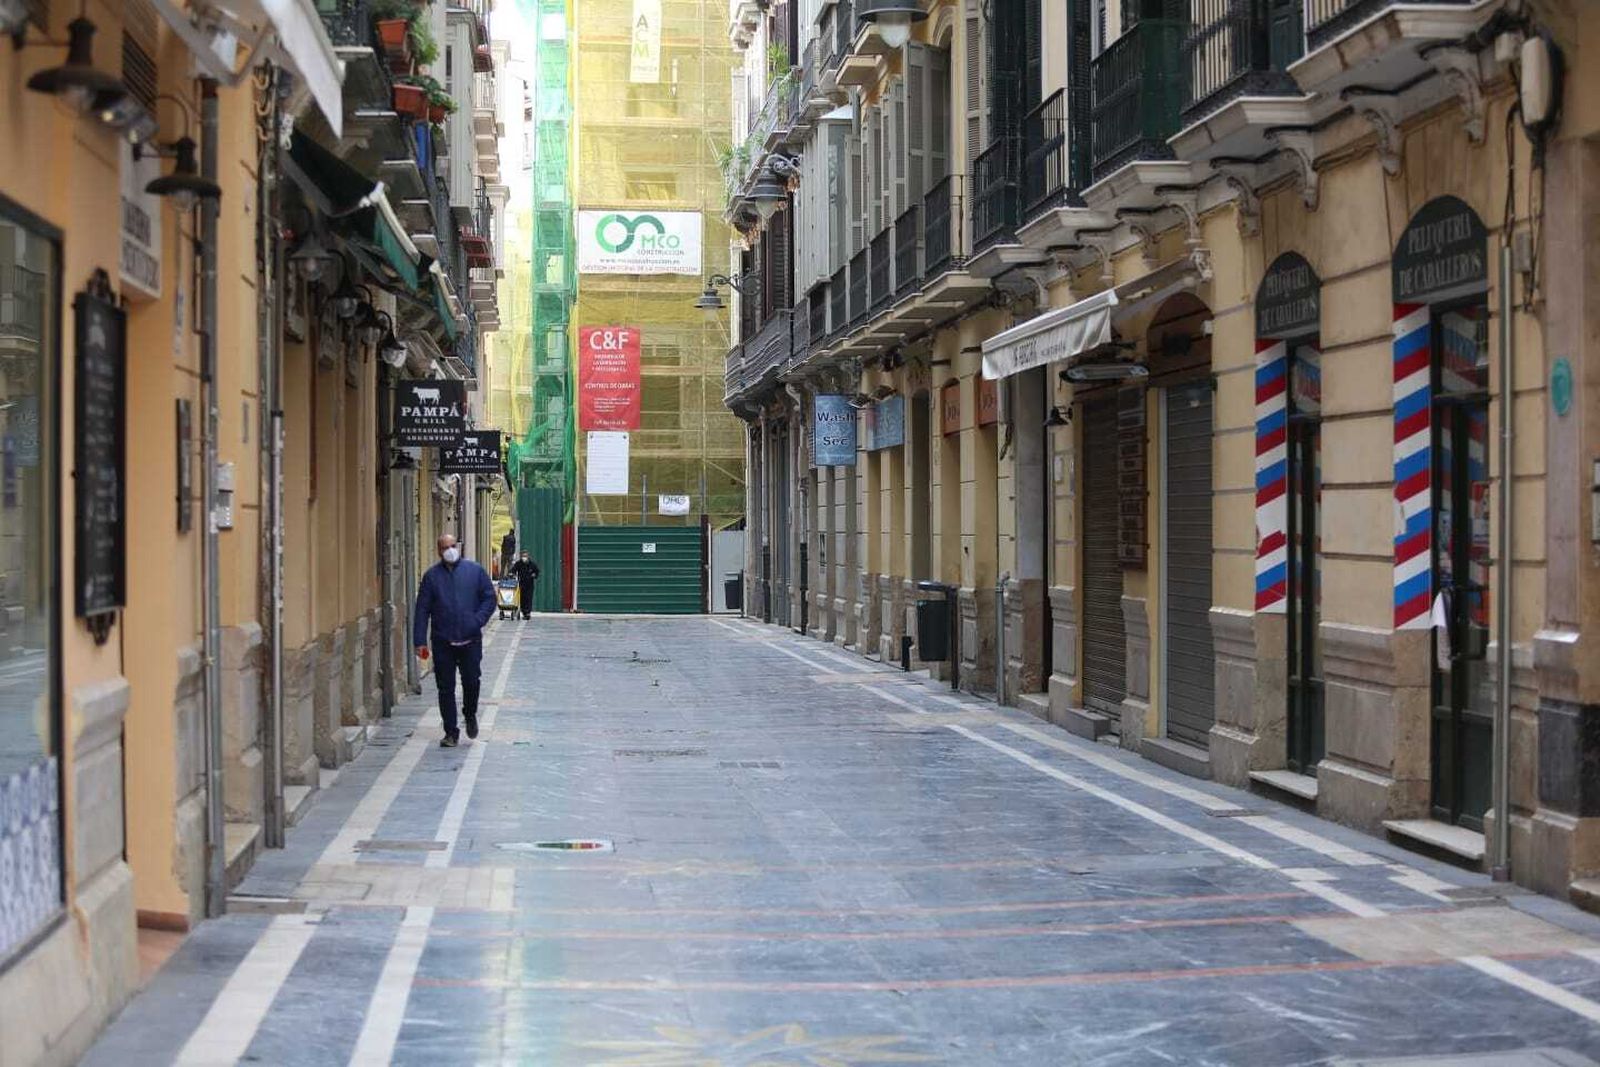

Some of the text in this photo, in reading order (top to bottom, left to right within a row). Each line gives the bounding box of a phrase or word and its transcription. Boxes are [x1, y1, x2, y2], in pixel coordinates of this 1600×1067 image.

[589, 331, 629, 350] C&F
[817, 411, 856, 422] Wash
[823, 436, 849, 446] Sec
